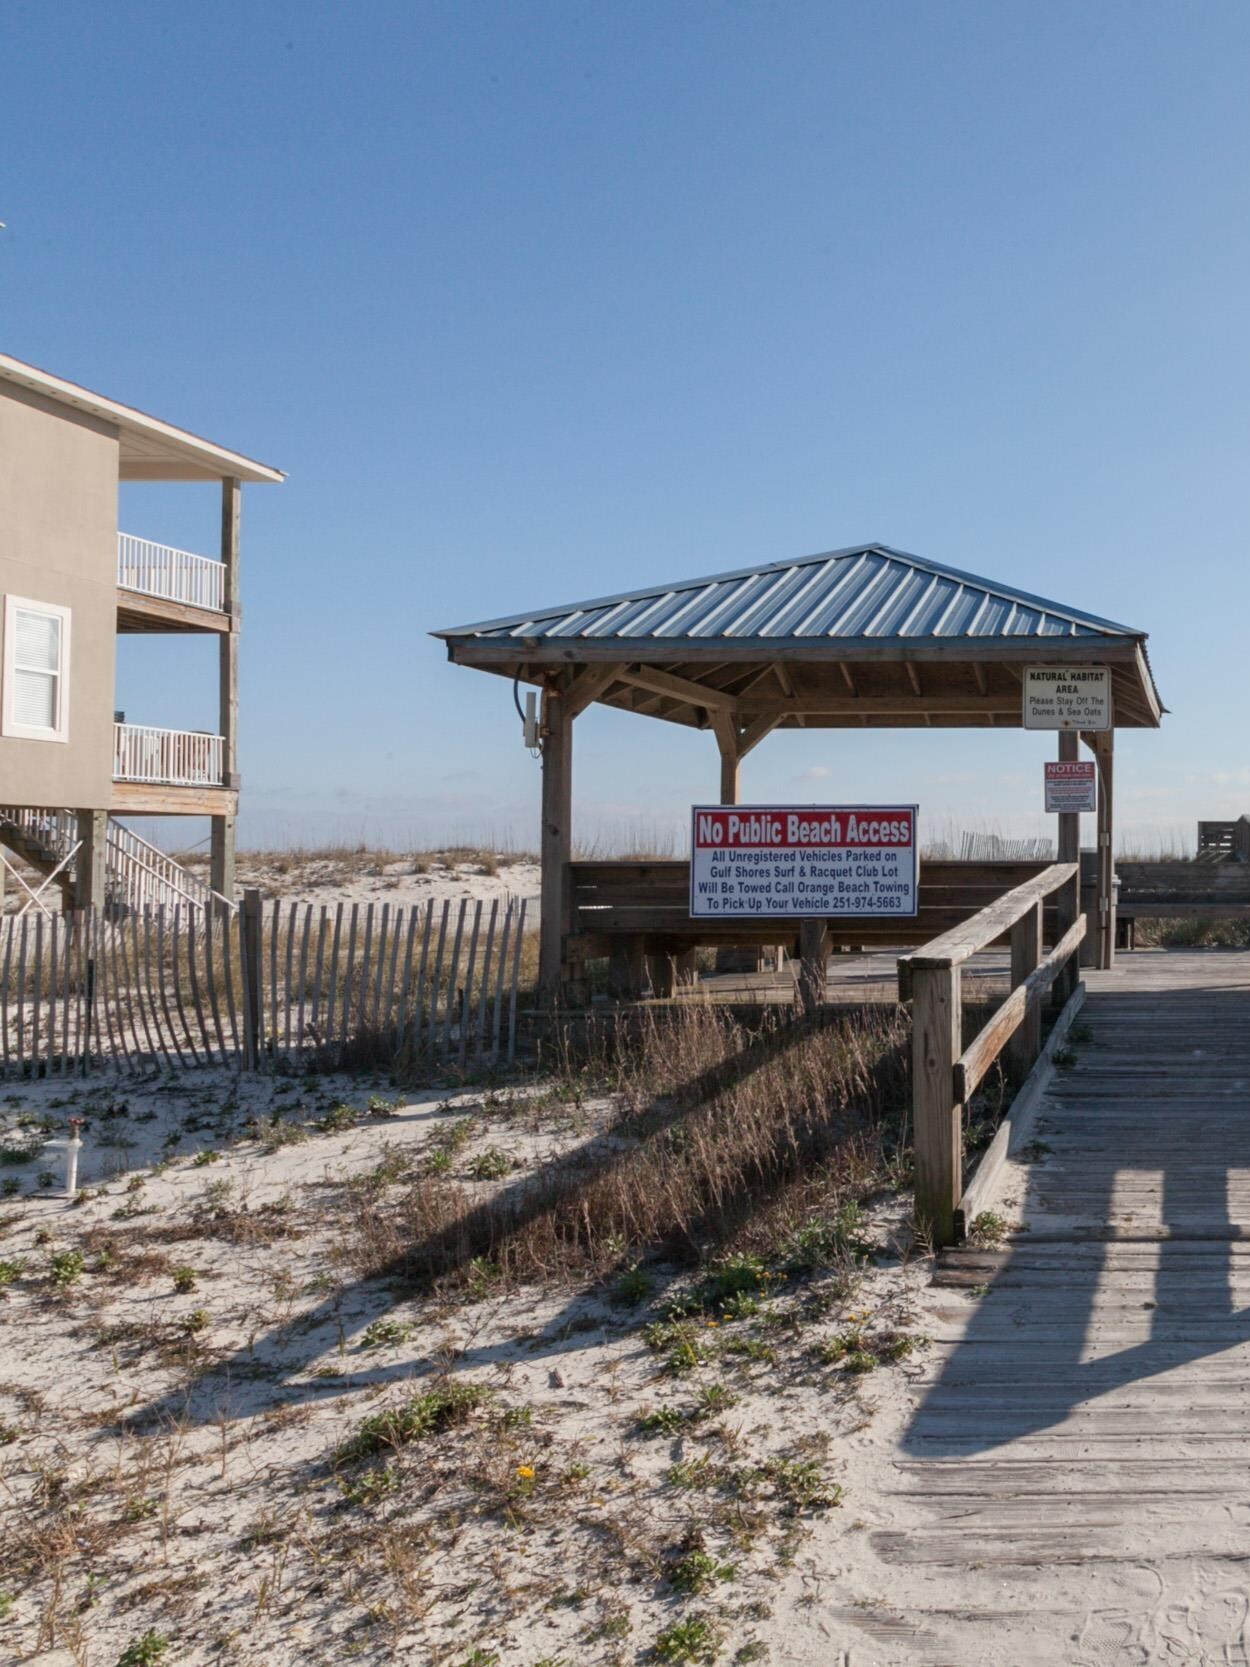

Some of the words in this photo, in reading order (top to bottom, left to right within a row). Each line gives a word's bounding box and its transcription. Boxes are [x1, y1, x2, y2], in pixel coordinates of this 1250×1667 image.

[1030, 672, 1067, 681] NATURAL
[1071, 673, 1104, 681] HABITAT
[1056, 685, 1078, 693] AREA
[1057, 697, 1073, 706] Stay
[1077, 697, 1088, 705] Off
[1091, 697, 1104, 705] The
[1032, 707, 1055, 715] Dunes
[1058, 708, 1063, 716] &
[1067, 708, 1081, 716] Sea
[1084, 708, 1101, 716] Oats
[1048, 764, 1092, 773] NOTICE
[700, 815, 722, 844] No
[728, 815, 782, 844] Public
[787, 815, 841, 843] Beach
[846, 814, 909, 843] Access
[712, 851, 725, 862] All
[729, 851, 796, 865] Unregistered
[800, 851, 842, 861] Vehicles
[846, 851, 881, 861] Parked
[884, 853, 896, 861] on
[710, 866, 731, 878] Gulf
[735, 866, 770, 878] Shores
[774, 866, 795, 878] Surf
[799, 867, 806, 877] &
[810, 866, 852, 880] Racquet
[856, 866, 878, 877] Club
[882, 866, 898, 877] Lot
[699, 882, 717, 894] Will
[721, 882, 734, 894] Be
[738, 882, 771, 894] Towed
[775, 882, 794, 893] Call
[798, 882, 834, 896] Orange
[838, 882, 870, 893] Beach
[874, 881, 909, 895] Towing
[707, 898, 719, 909] To
[722, 898, 745, 909] Pick
[747, 898, 762, 911] Up
[765, 898, 789, 909] Your
[792, 897, 830, 908] Vehicle
[833, 897, 901, 908] 251-974-5663
